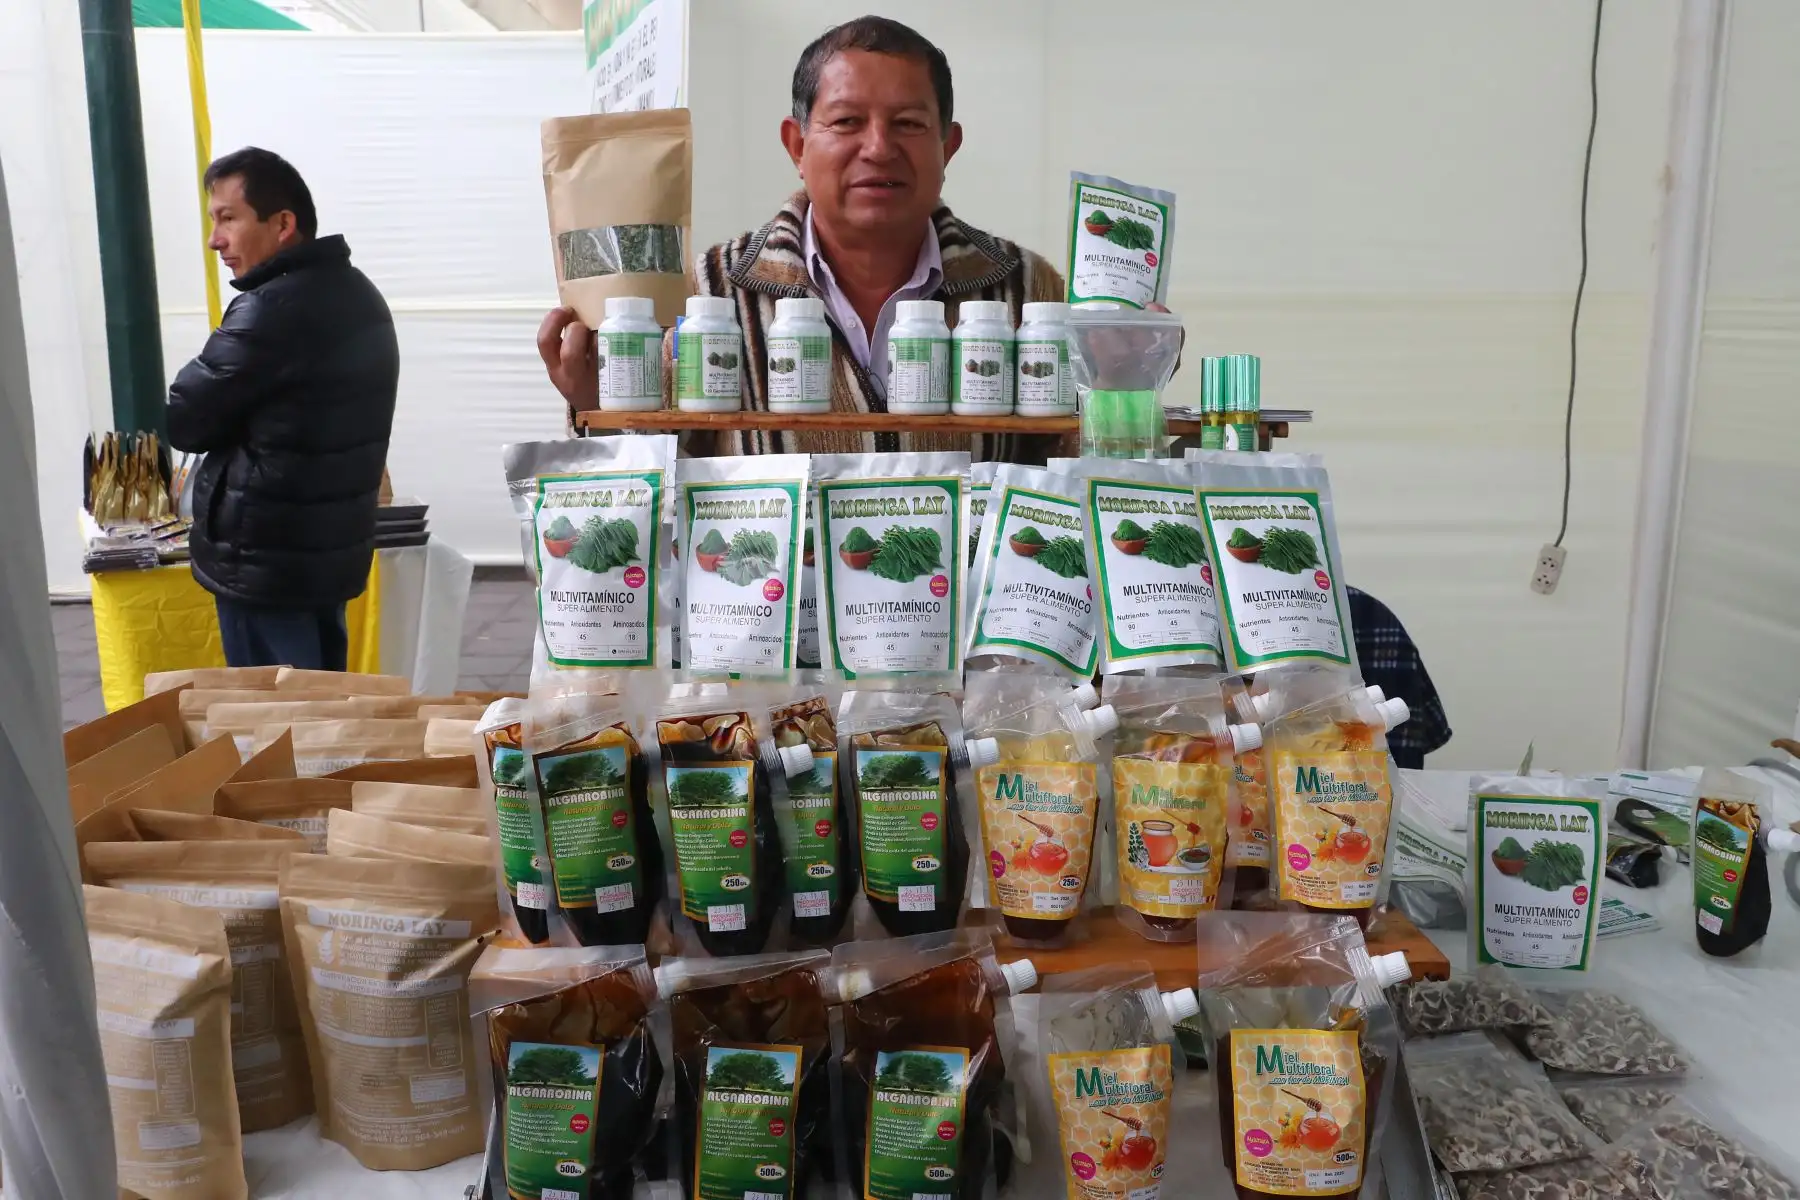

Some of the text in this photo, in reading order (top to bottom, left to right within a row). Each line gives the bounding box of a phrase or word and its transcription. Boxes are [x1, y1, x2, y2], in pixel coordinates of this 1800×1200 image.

[695, 499, 757, 520] MORINGA
[830, 497, 910, 519] MORINGA
[912, 496, 946, 515] LAY
[1098, 496, 1173, 515] MORINGA
[1210, 505, 1281, 521] MORINGA
[1009, 504, 1083, 531] MORINGA
[550, 590, 634, 604] MULTIVITAMÍNICO
[1123, 581, 1213, 598] MULTIVITAMÍNICO
[1243, 588, 1328, 604] MULTIVITAMÍNICO
[1003, 582, 1091, 615] MULTIVITAMÍNICO
[1009, 593, 1081, 618] SUPER ALIMENTO
[1135, 593, 1207, 604] SUPER ALIMENTO
[1255, 601, 1321, 611] SUPER ALIMENTO
[558, 604, 624, 612] SUPER ALIMENTO
[690, 602, 772, 618] MULTIVITAMÍNICO
[845, 599, 941, 616] MULTIVITAMÍNICO
[695, 615, 761, 627] SUPER ALIMENTO
[856, 614, 932, 625] SUPER ALIMENTO
[1117, 611, 1149, 621] Nutrientes
[1240, 618, 1271, 629] Nutrientes
[549, 787, 625, 807] ALGARROBINA
[862, 790, 937, 802] ALGARROBINA
[671, 807, 746, 819] ALGARROBINA
[279, 820, 327, 832] MORIN
[1486, 811, 1589, 833] MORINGA LAY
[1494, 903, 1580, 919] MULTIVITAMÍNICO
[328, 912, 447, 936] MORINGA LAY
[1504, 915, 1573, 927] SUPER ALIMENTO
[1486, 927, 1515, 937] Nutrientes
[509, 1086, 593, 1101] ALGARROBINA
[707, 1091, 789, 1106] ALGARROBINA
[876, 1091, 957, 1108] ALGARROBINA
[560, 1165, 575, 1174] 500
[760, 1168, 775, 1177] 500
[929, 1169, 945, 1178] 500
